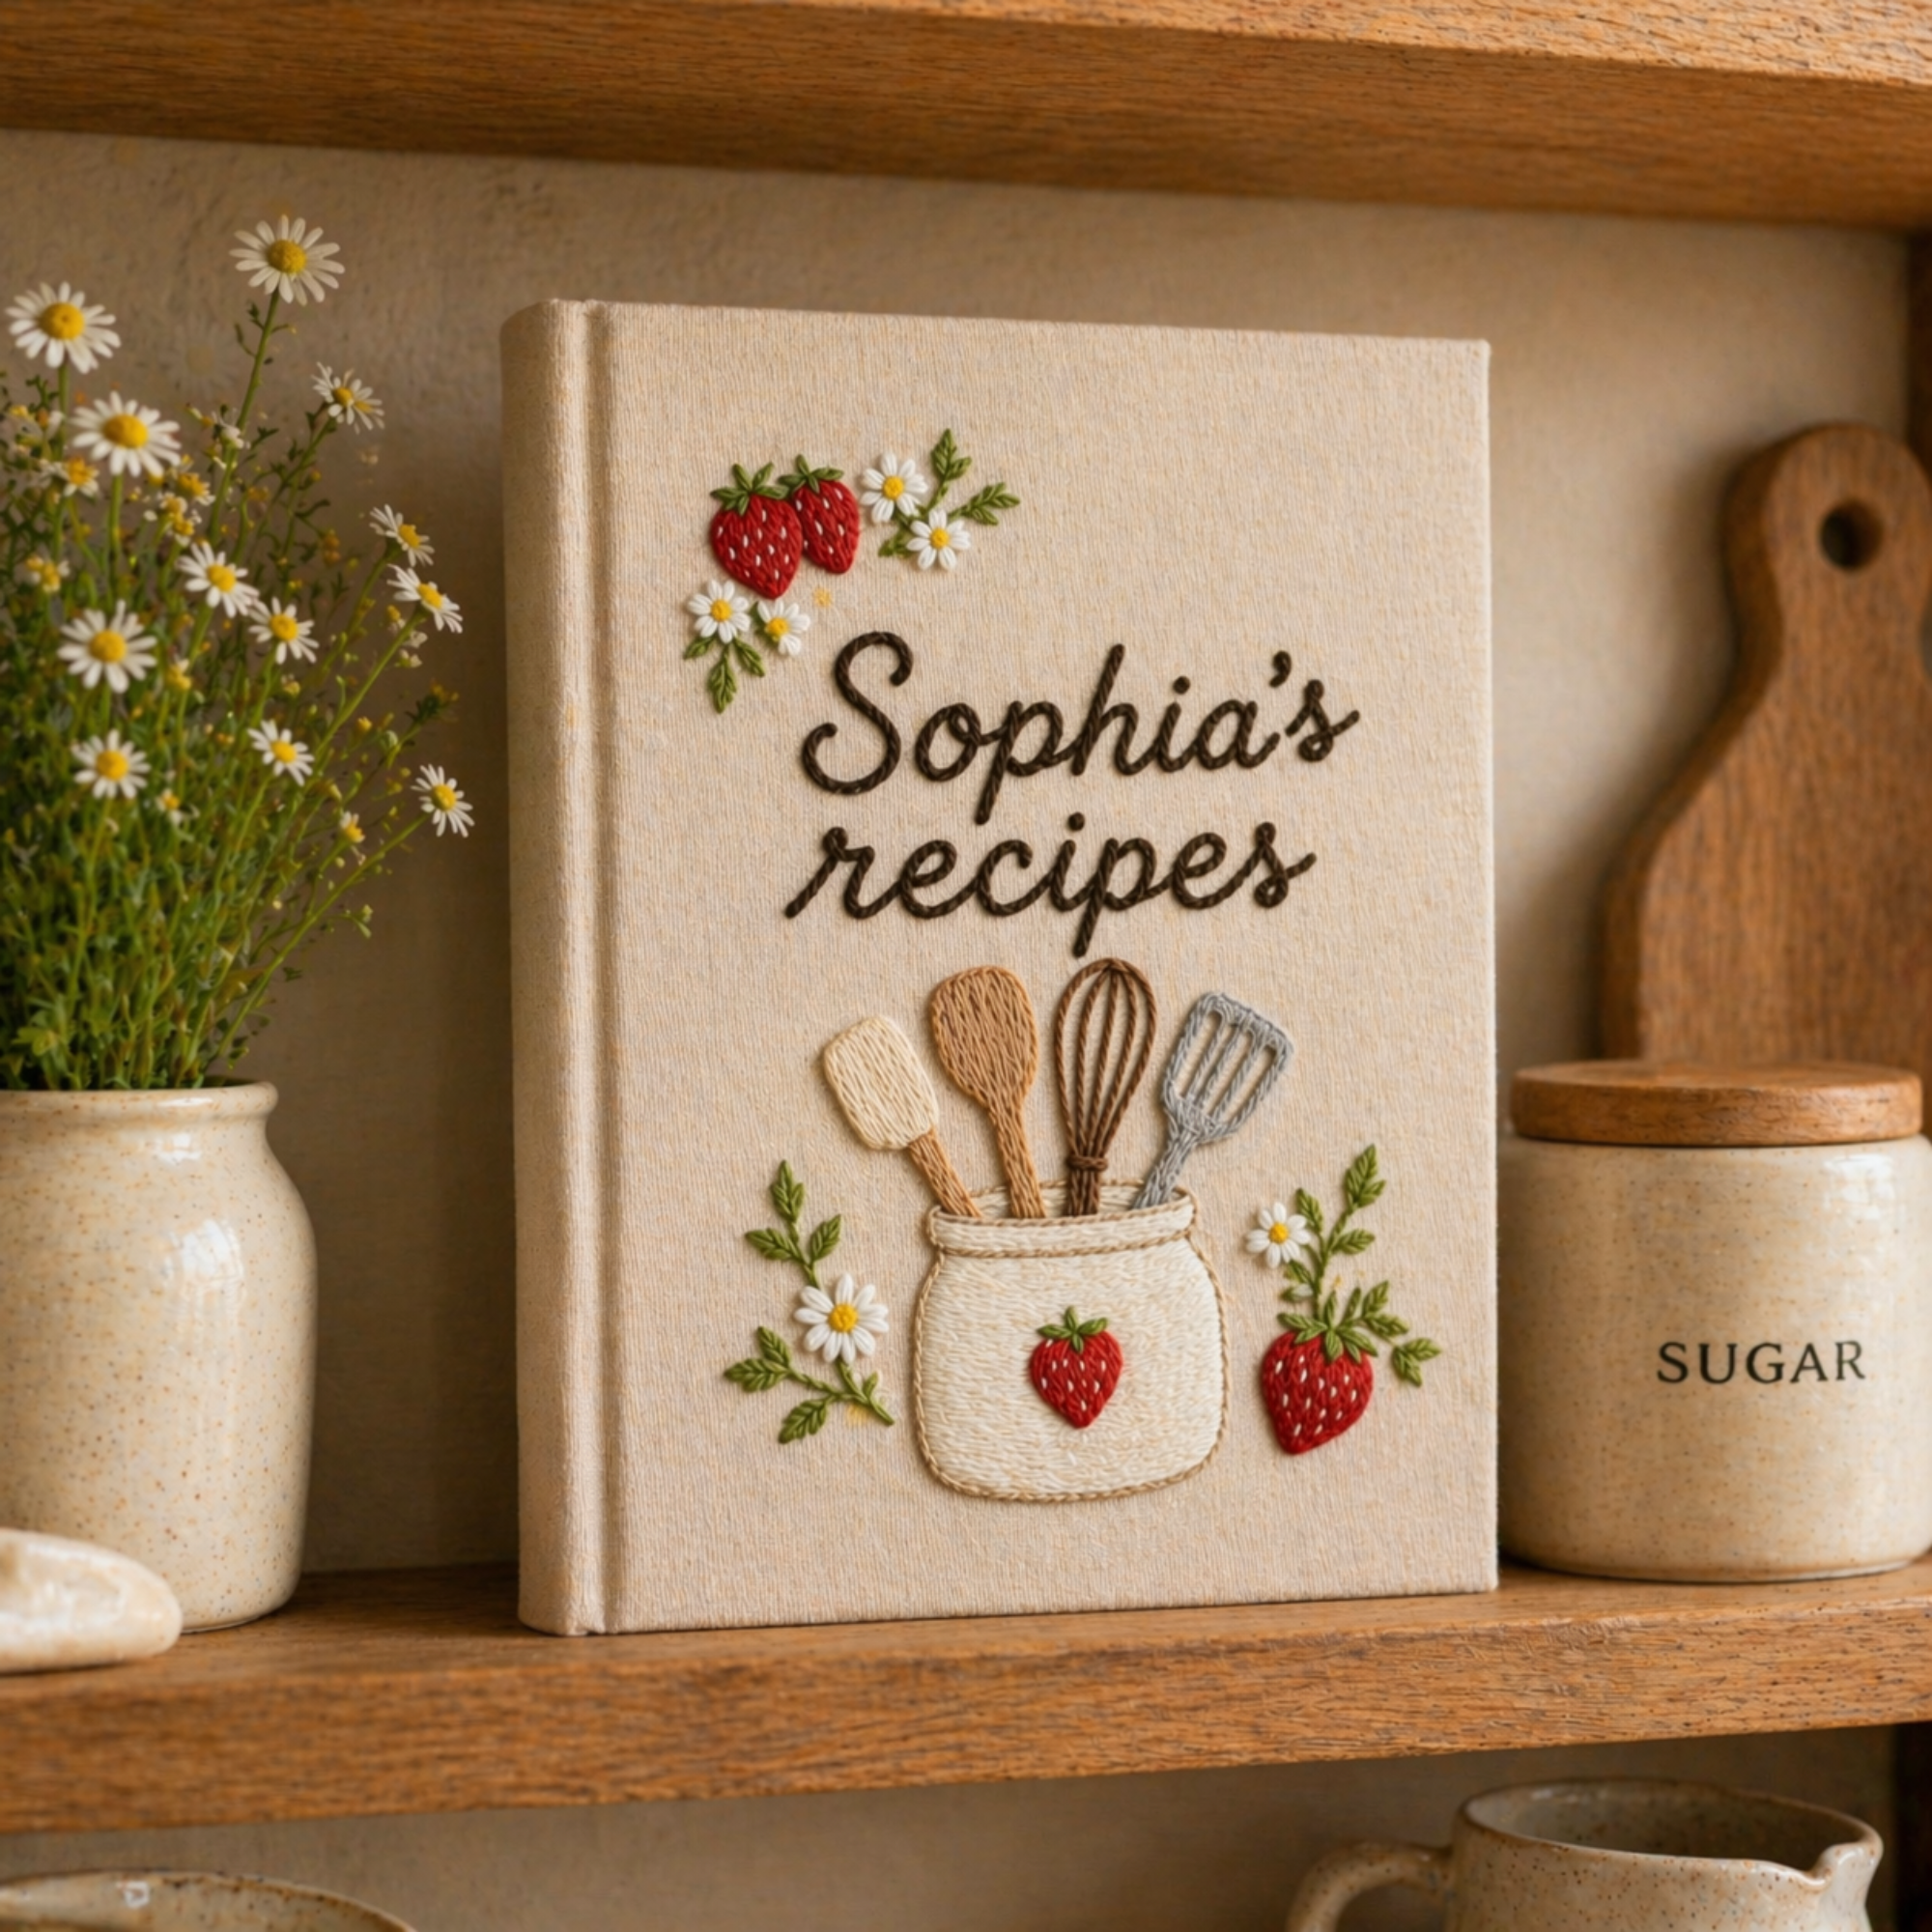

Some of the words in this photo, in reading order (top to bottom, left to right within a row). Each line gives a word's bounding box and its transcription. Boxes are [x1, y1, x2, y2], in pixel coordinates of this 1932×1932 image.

[799, 631, 1360, 826] Sophia's
[783, 811, 1318, 958] recipes
[1656, 1340, 1866, 1385] SUGAR
